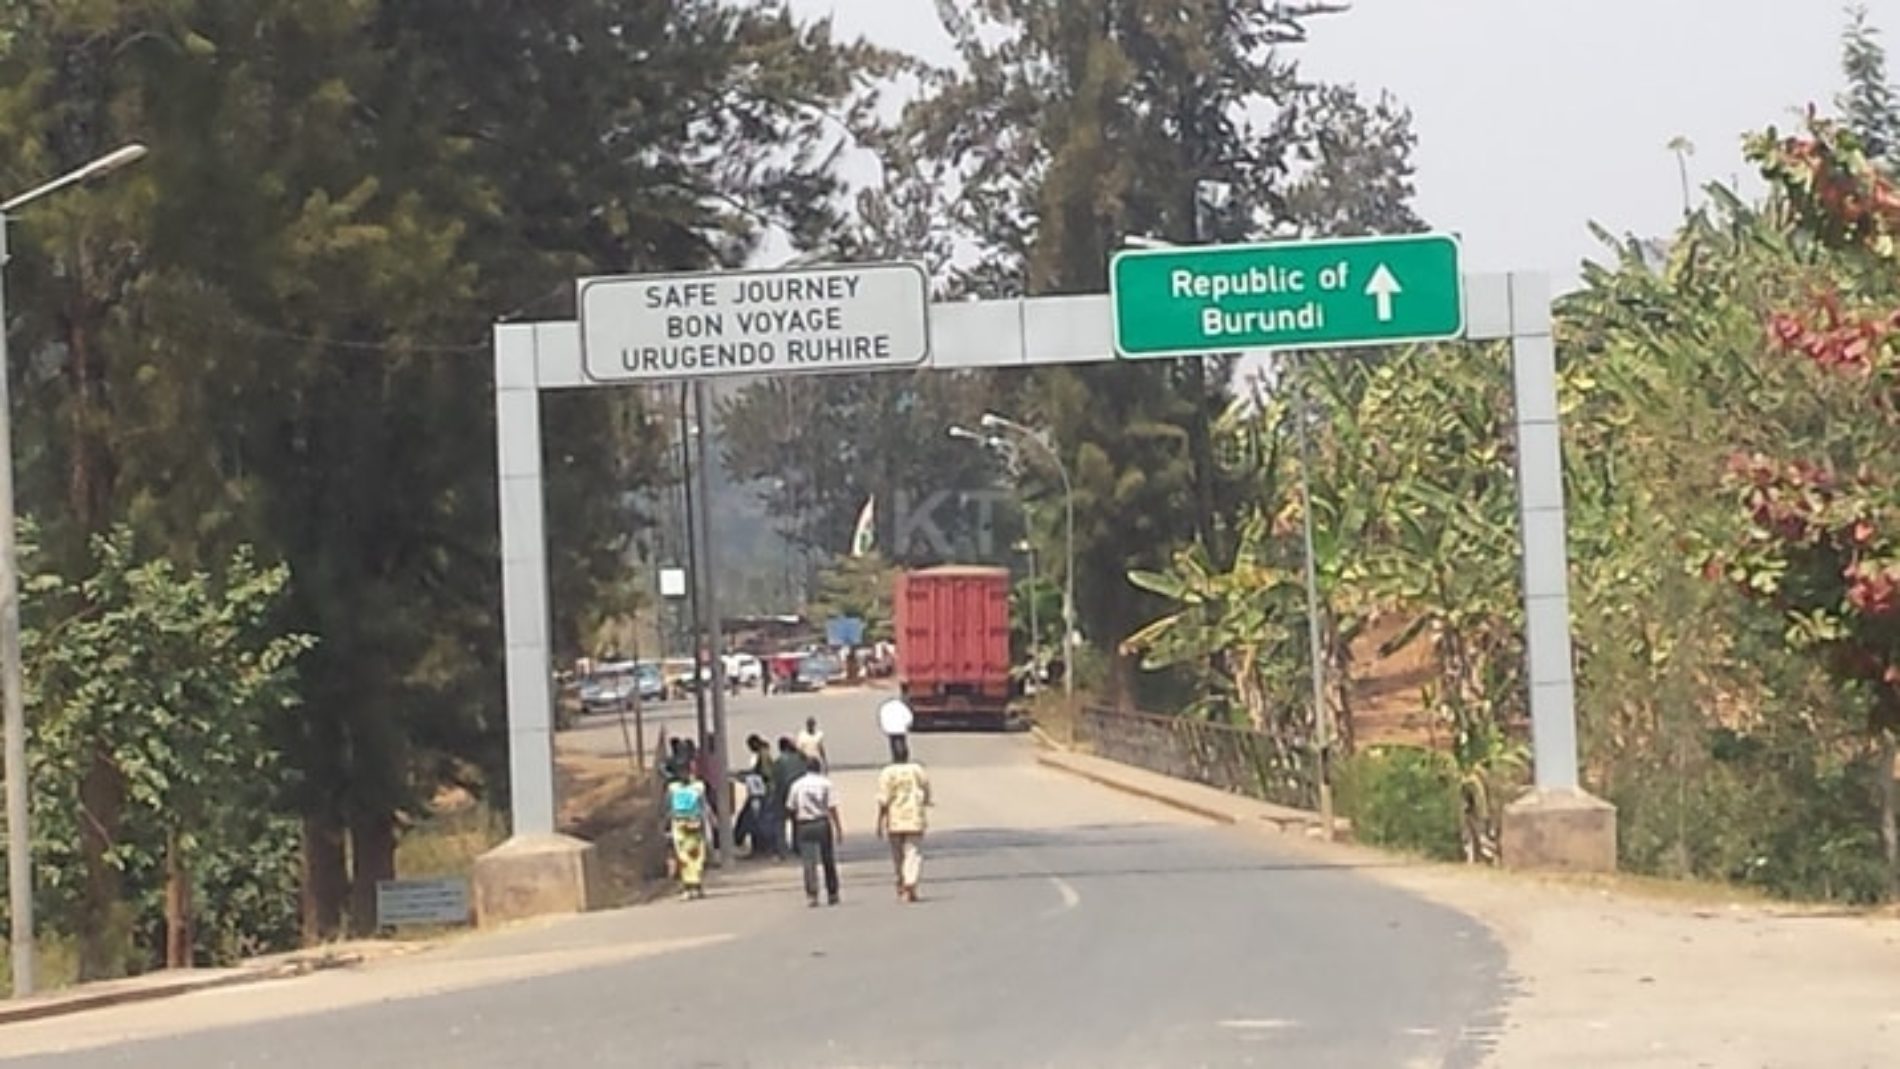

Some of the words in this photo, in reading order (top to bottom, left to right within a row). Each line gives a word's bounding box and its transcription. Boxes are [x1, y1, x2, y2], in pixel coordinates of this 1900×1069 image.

[645, 284, 717, 308] SAFE
[732, 276, 860, 304] JOURNEY
[1171, 267, 1304, 301] Republic
[1319, 262, 1348, 288] of
[667, 314, 723, 339] BON
[737, 307, 842, 335] VOYAGE
[1202, 302, 1323, 335] Burundi
[621, 341, 774, 372] URUGENDO
[786, 335, 890, 362] RUHIRE
